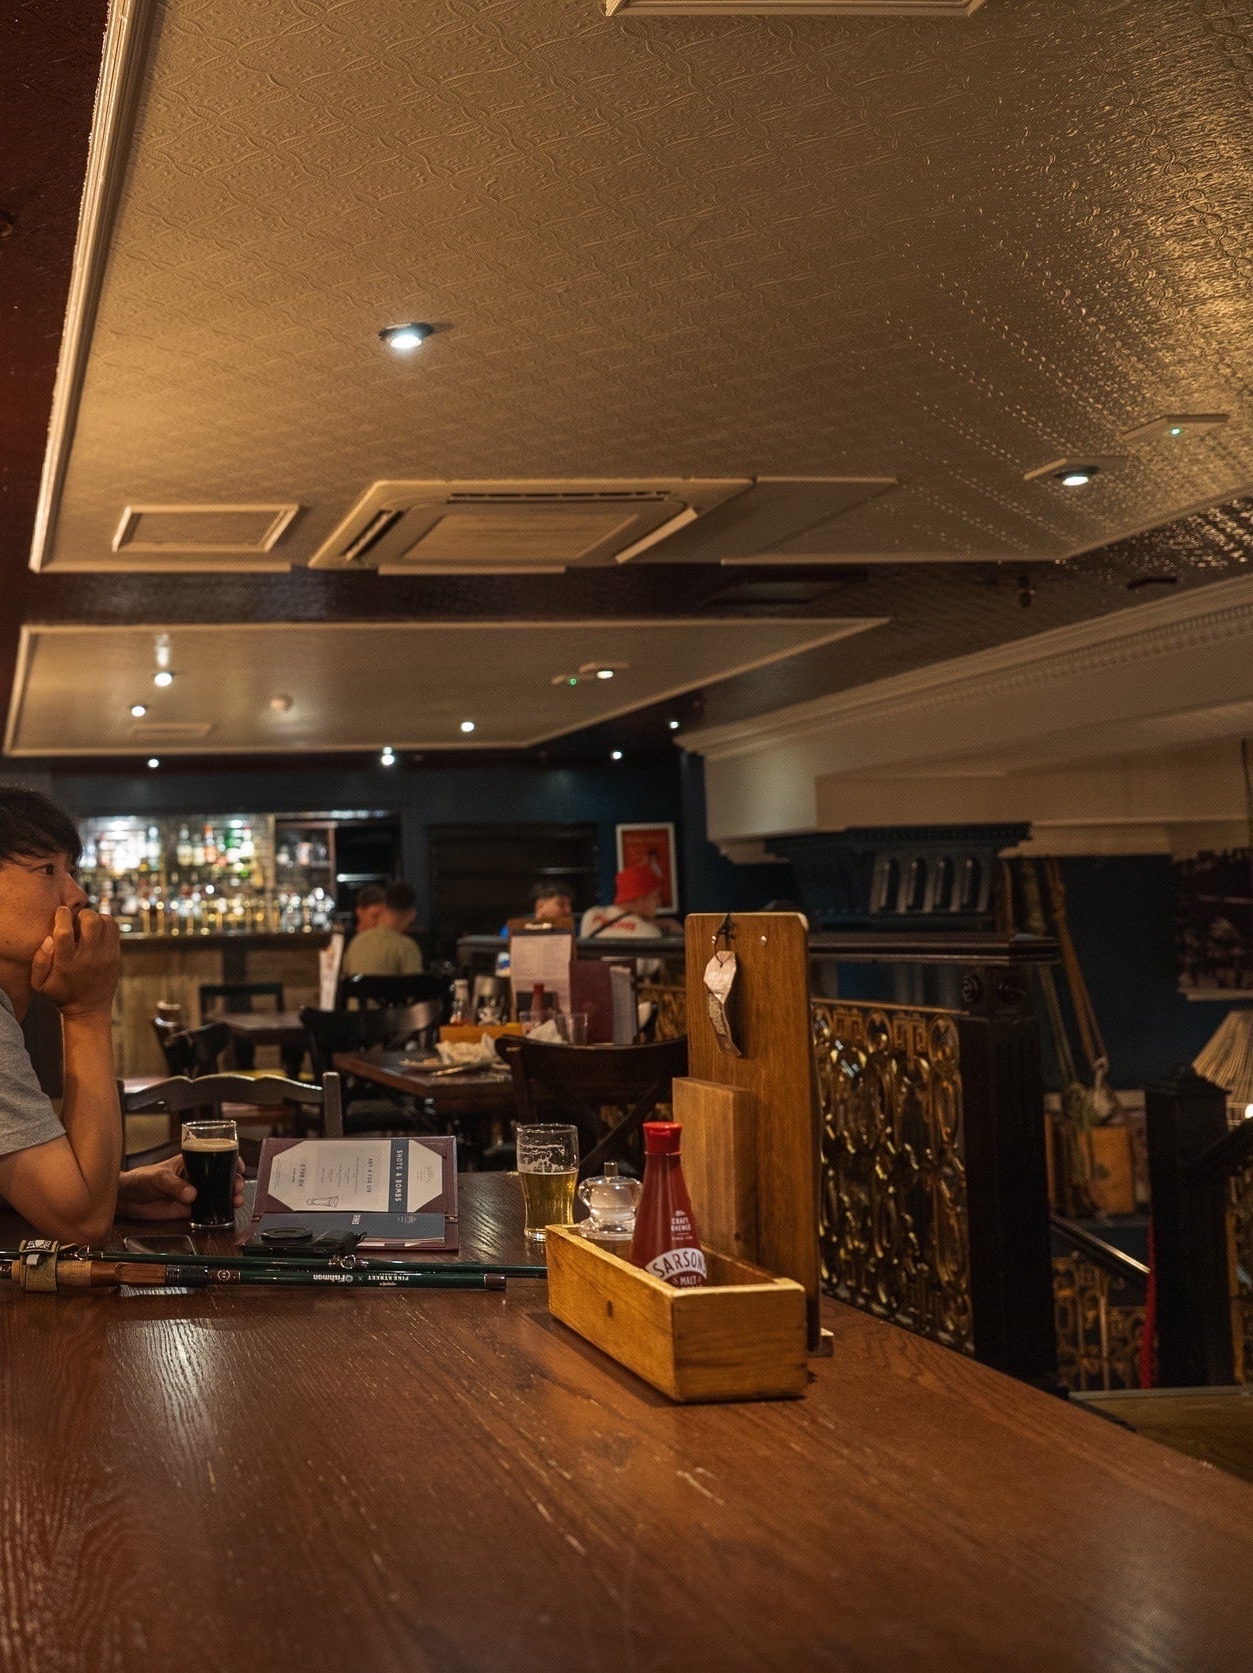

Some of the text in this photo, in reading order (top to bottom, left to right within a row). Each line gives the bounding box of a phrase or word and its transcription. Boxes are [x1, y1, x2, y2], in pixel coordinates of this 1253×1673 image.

[395, 1149, 404, 1170] SHOTS
[394, 1179, 403, 1202] BOMBS
[652, 1250, 706, 1279] SARSON
[679, 1274, 697, 1286] MALT
